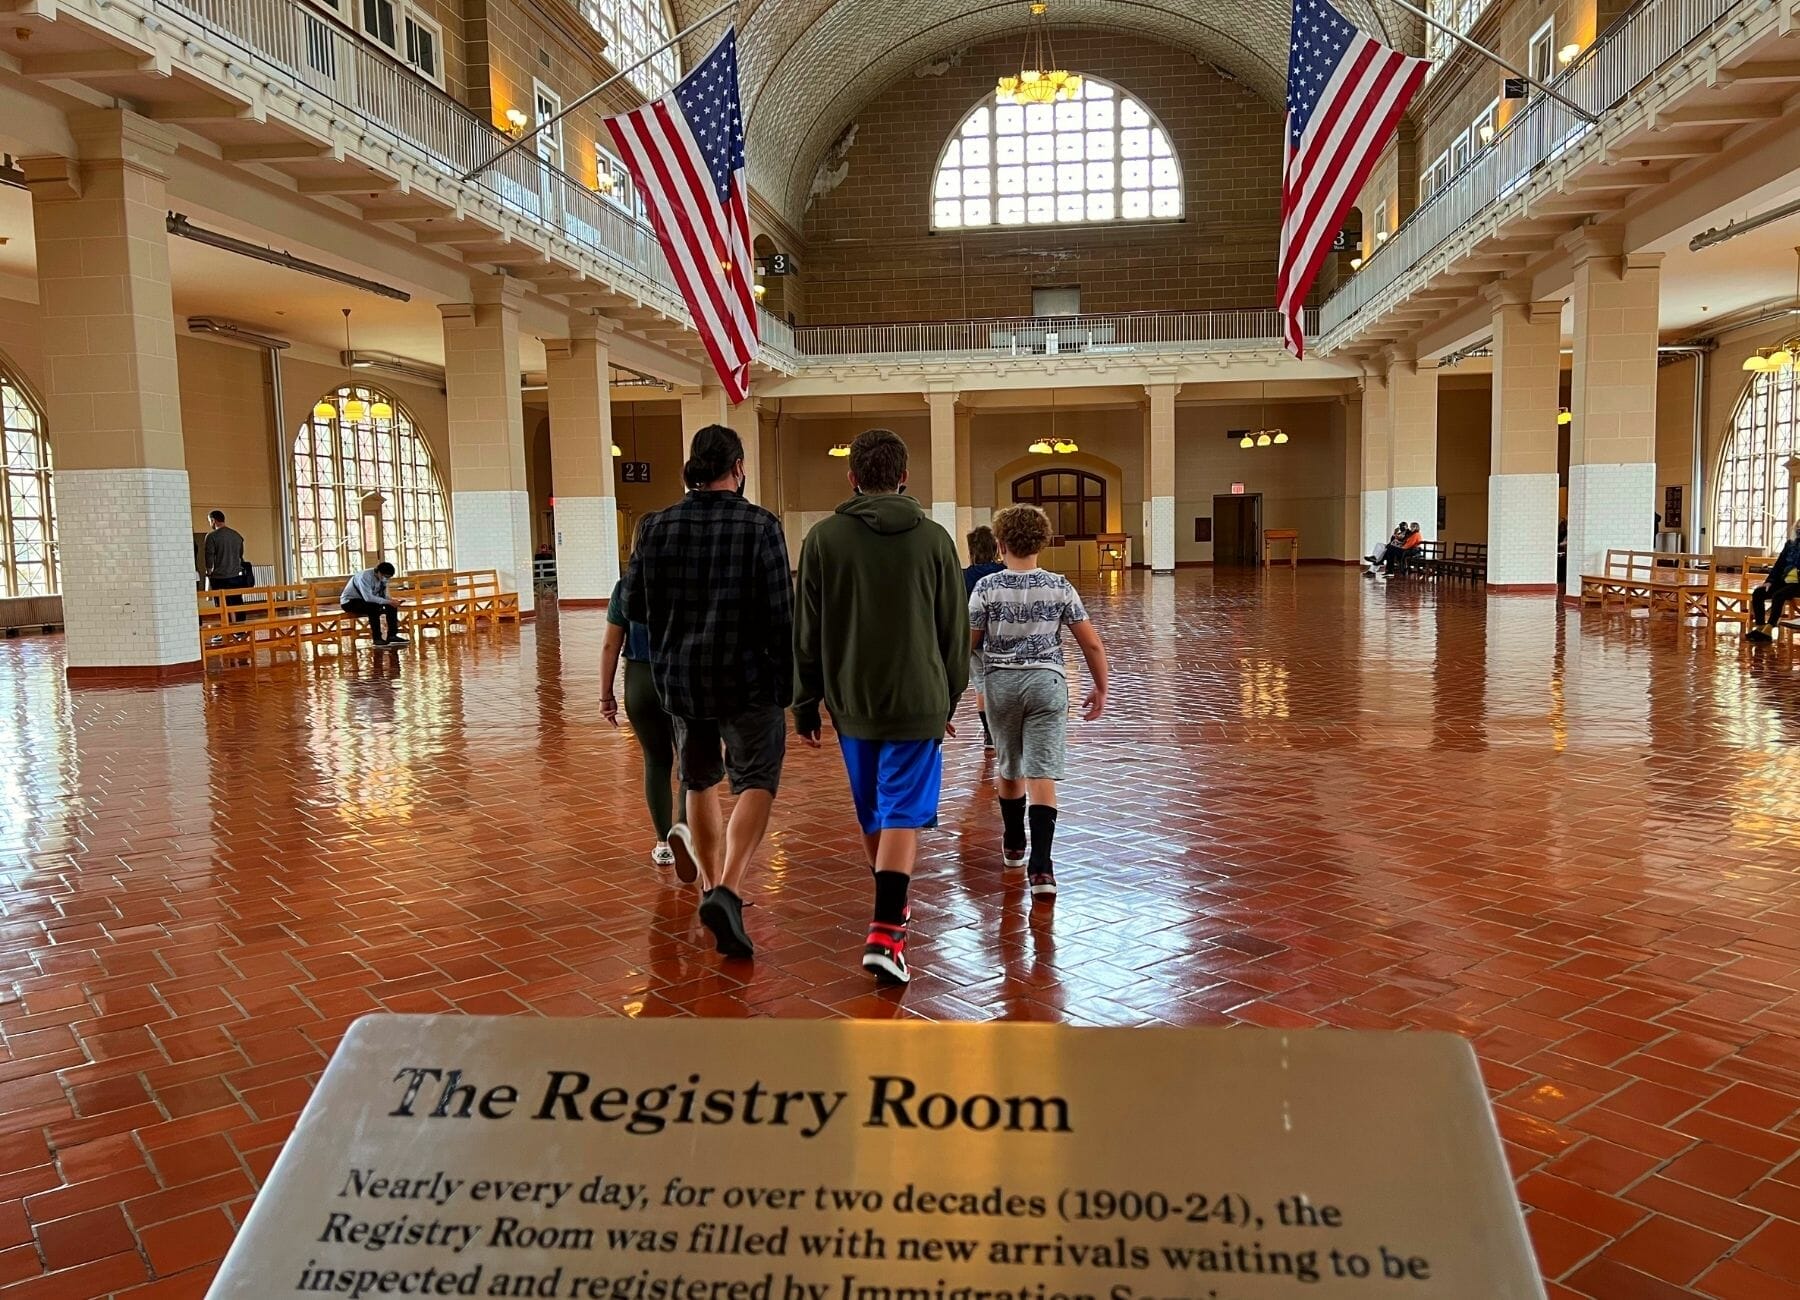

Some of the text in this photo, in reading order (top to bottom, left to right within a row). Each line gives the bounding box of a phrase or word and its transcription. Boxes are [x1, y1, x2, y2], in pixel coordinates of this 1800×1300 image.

[1333, 230, 1345, 246] 3
[774, 254, 785, 270] 3
[625, 463, 635, 477] 2
[640, 463, 648, 477] 2
[388, 1068, 1073, 1138] The Registry Room
[338, 1169, 1342, 1228] Nearly every day, for over two decades (1900-24), the
[317, 1213, 1429, 1282] Registry Room was filled with new arrivals waiting to be
[296, 1259, 482, 1300] inspected
[487, 1267, 562, 1298] and
[568, 1270, 773, 1300] registered
